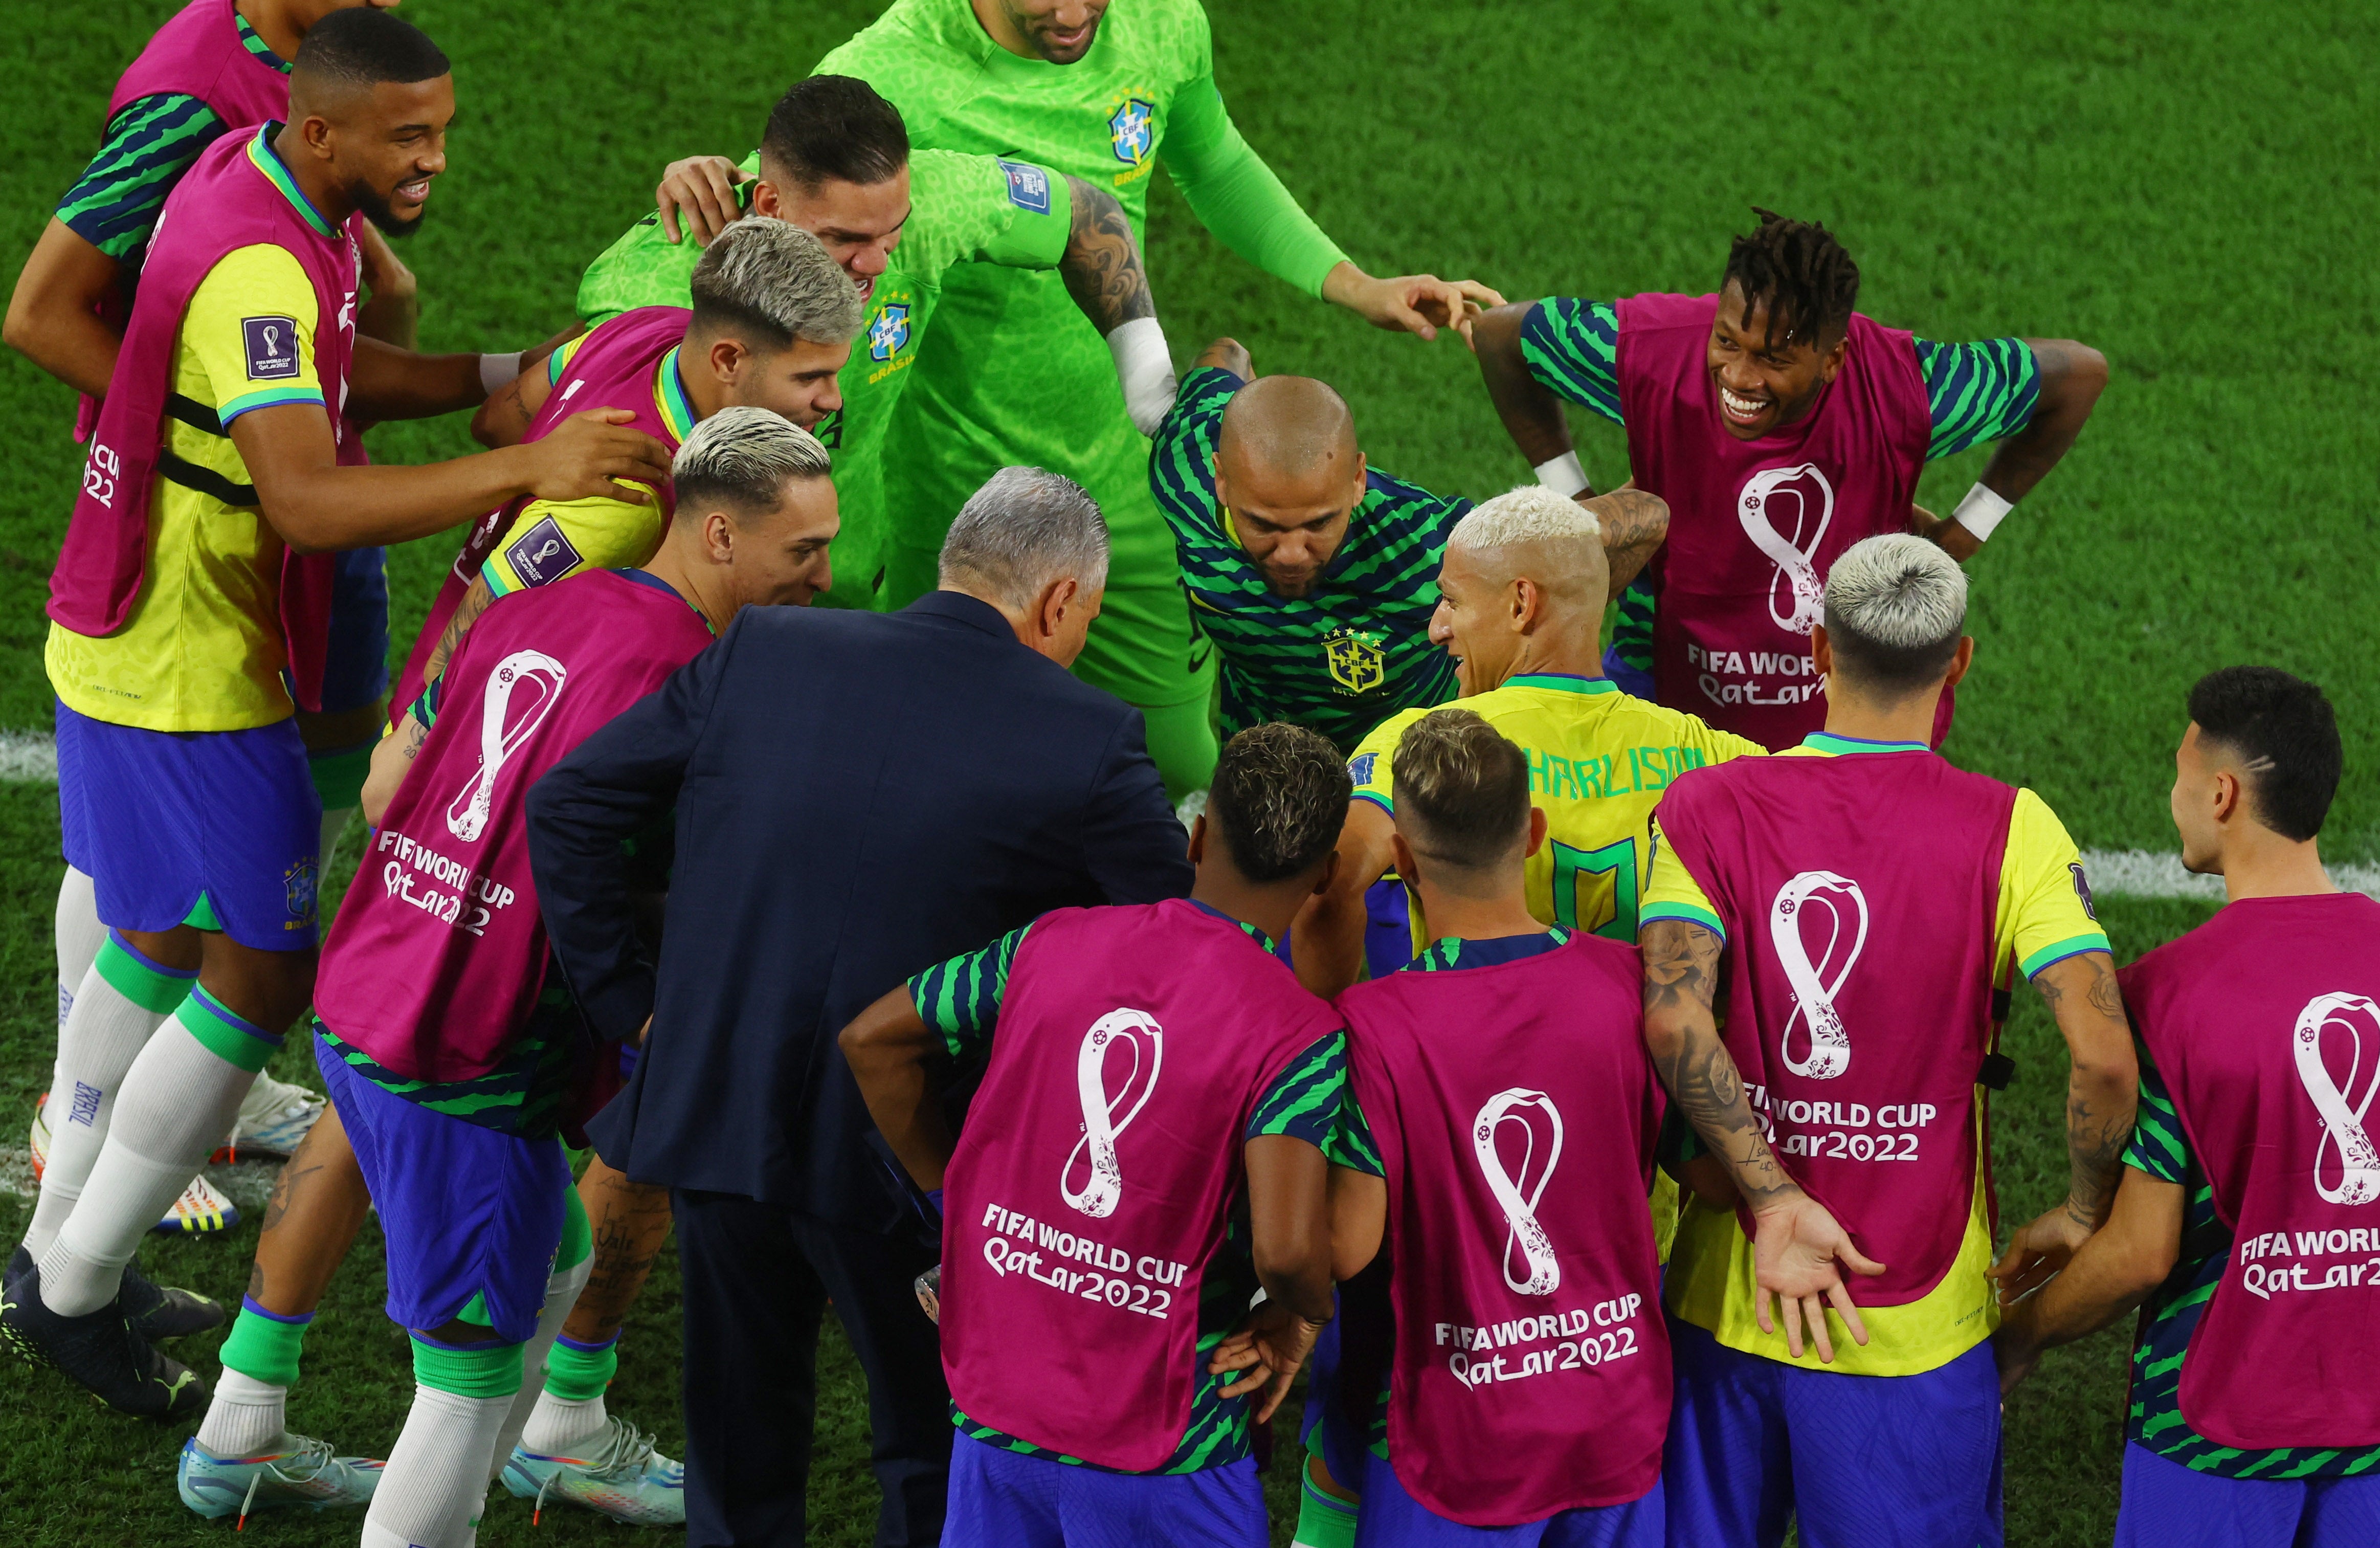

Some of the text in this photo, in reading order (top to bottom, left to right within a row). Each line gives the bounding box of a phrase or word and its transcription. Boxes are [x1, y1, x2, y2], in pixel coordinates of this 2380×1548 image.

[1123, 123, 1139, 136] CBF
[879, 324, 896, 339] CBF
[535, 571, 543, 580] CUP
[1345, 658, 1364, 667] CBF
[1688, 643, 1746, 674] FIFA
[377, 830, 515, 910] FIF WORL CUP
[69, 1080, 102, 1127] BRASIL
[1876, 1103, 1937, 1129] CUP
[981, 1203, 1035, 1243] FIFA
[1038, 1222, 1131, 1273] WORLD
[2240, 1232, 2293, 1267] FIFA
[983, 1236, 1171, 1319] Qatar2022
[1435, 1293, 1642, 1352] FIFA WORLD CUP
[1449, 1326, 1638, 1392] Qatar2022
